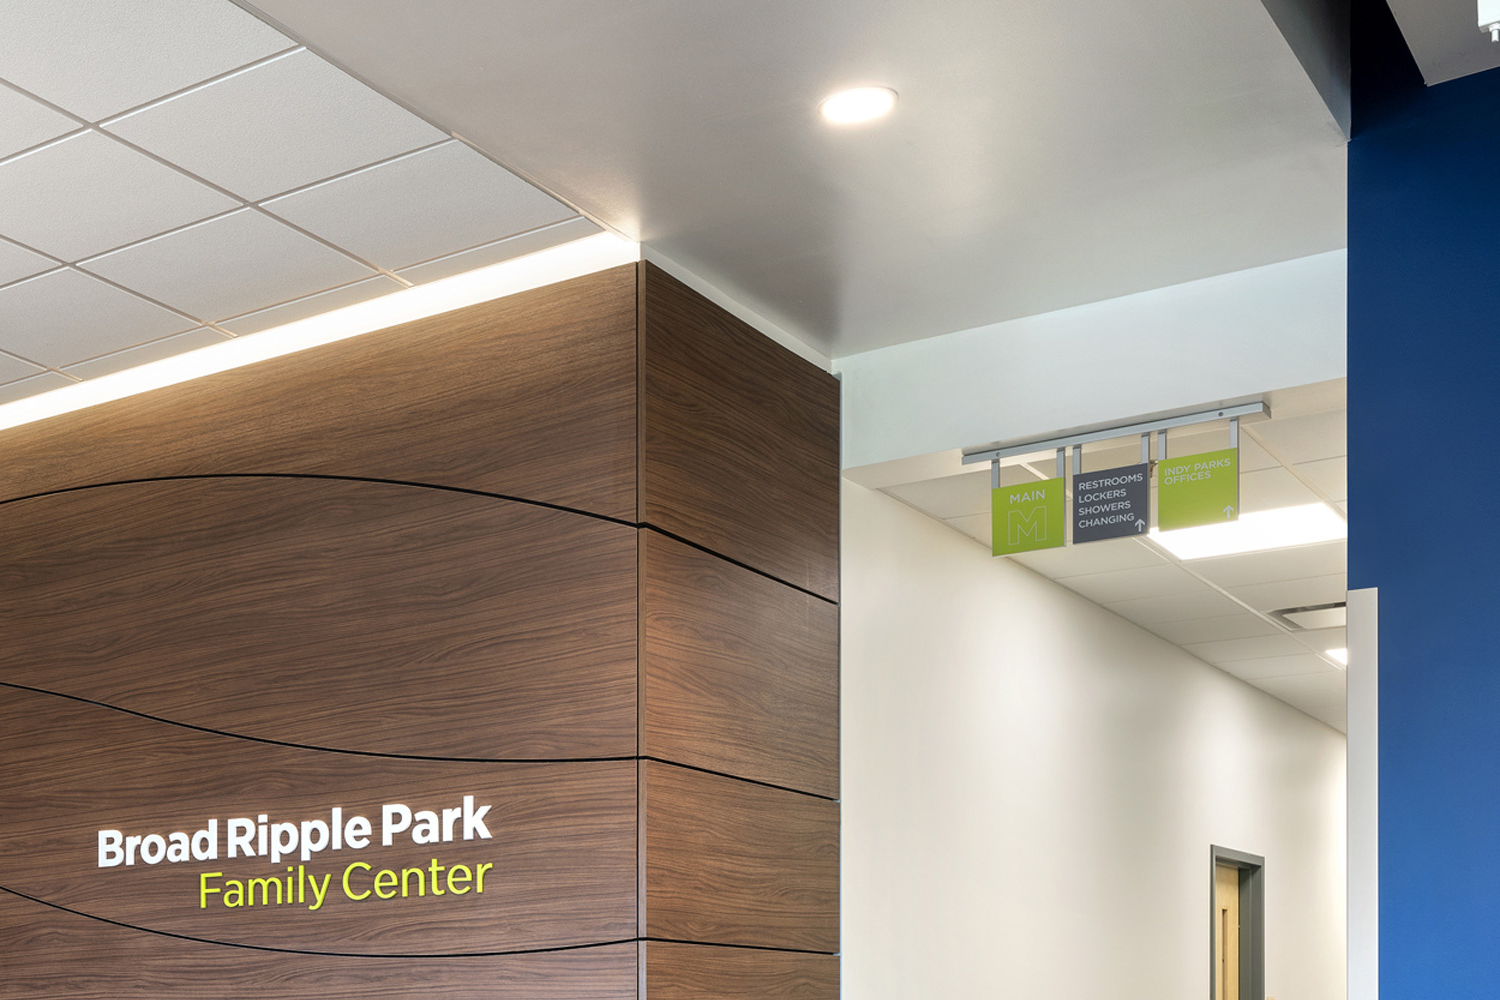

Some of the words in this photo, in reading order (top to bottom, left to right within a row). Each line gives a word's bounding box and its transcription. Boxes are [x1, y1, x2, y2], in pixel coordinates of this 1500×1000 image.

[1164, 464, 1190, 476] INDY
[1195, 457, 1231, 471] PARKS
[1078, 473, 1143, 491] RESTROOMS
[1164, 470, 1211, 486] OFFICES
[1009, 489, 1046, 505] MAIN
[1078, 488, 1127, 503] LOCKERS
[1078, 500, 1131, 516] SHOWERS
[1008, 505, 1047, 546] M
[1078, 513, 1135, 529] CHANGING
[97, 819, 218, 868] Broad
[226, 807, 372, 864] Ripple
[381, 795, 493, 846] Park
[199, 865, 332, 910] Family
[342, 858, 493, 901] Center
